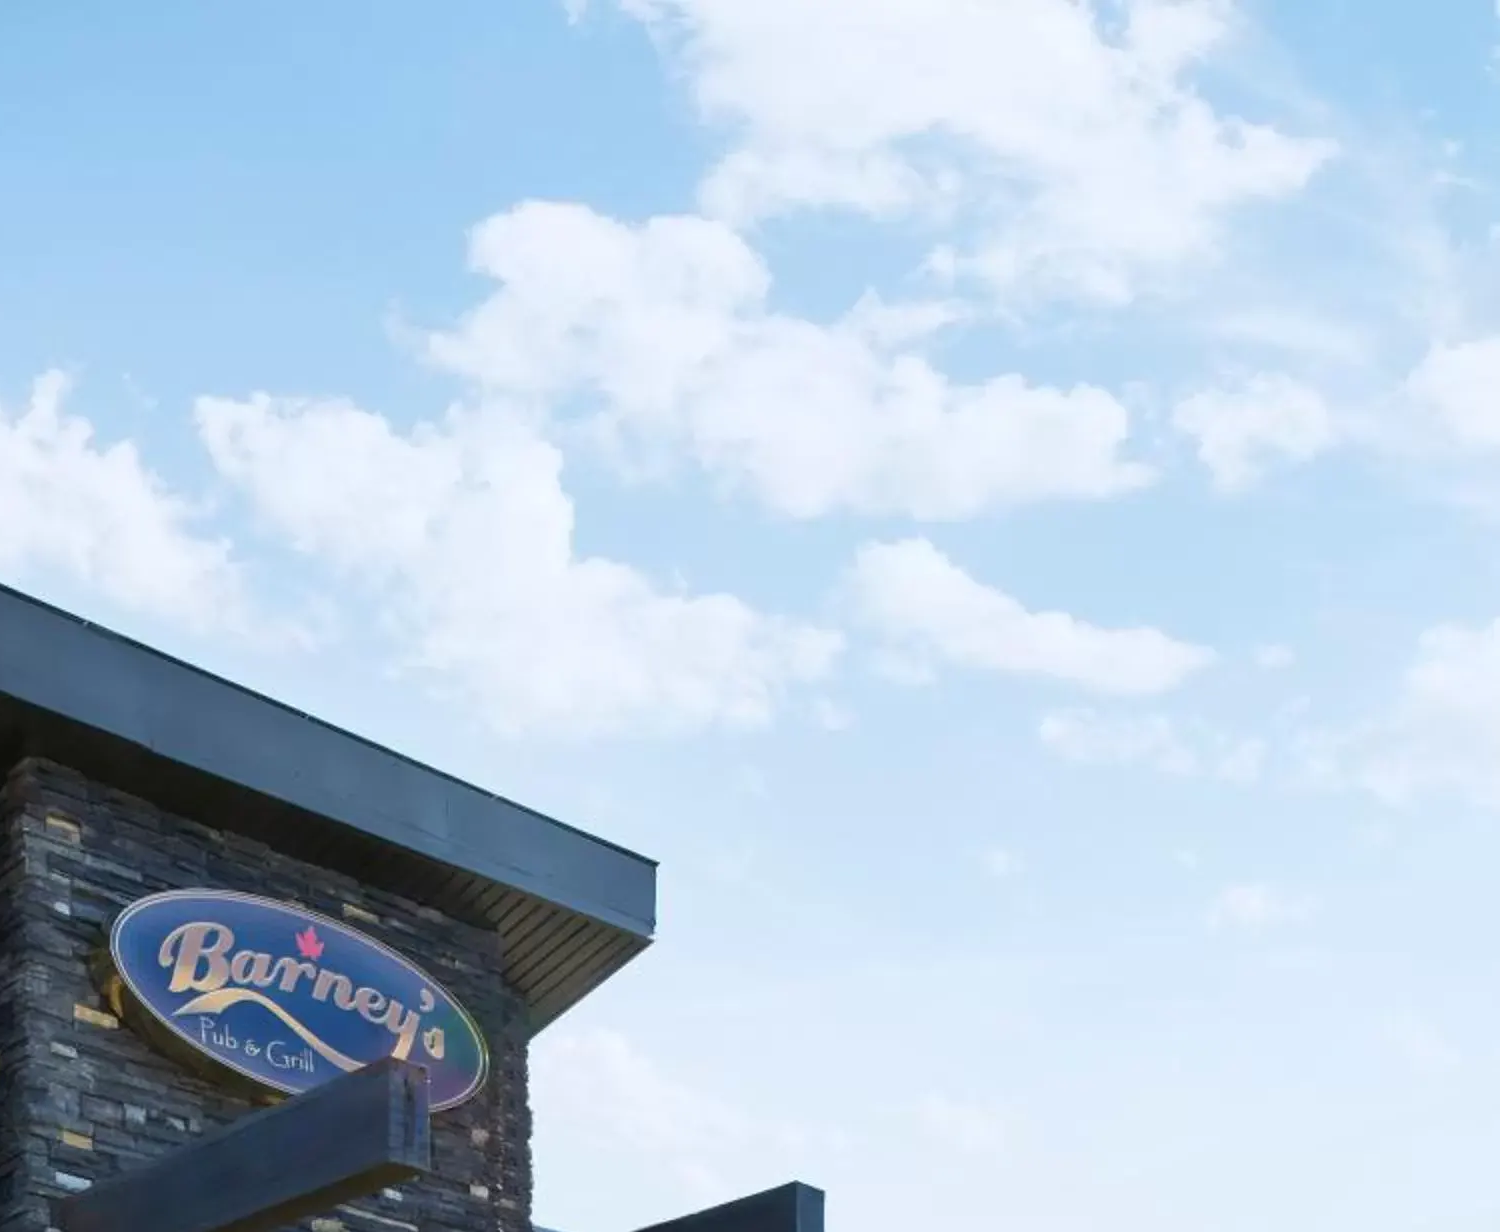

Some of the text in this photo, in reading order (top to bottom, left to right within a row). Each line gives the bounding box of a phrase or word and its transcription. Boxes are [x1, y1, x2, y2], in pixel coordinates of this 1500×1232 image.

[157, 920, 446, 1061] Barney's
[198, 1015, 316, 1073] Pub & Grill
